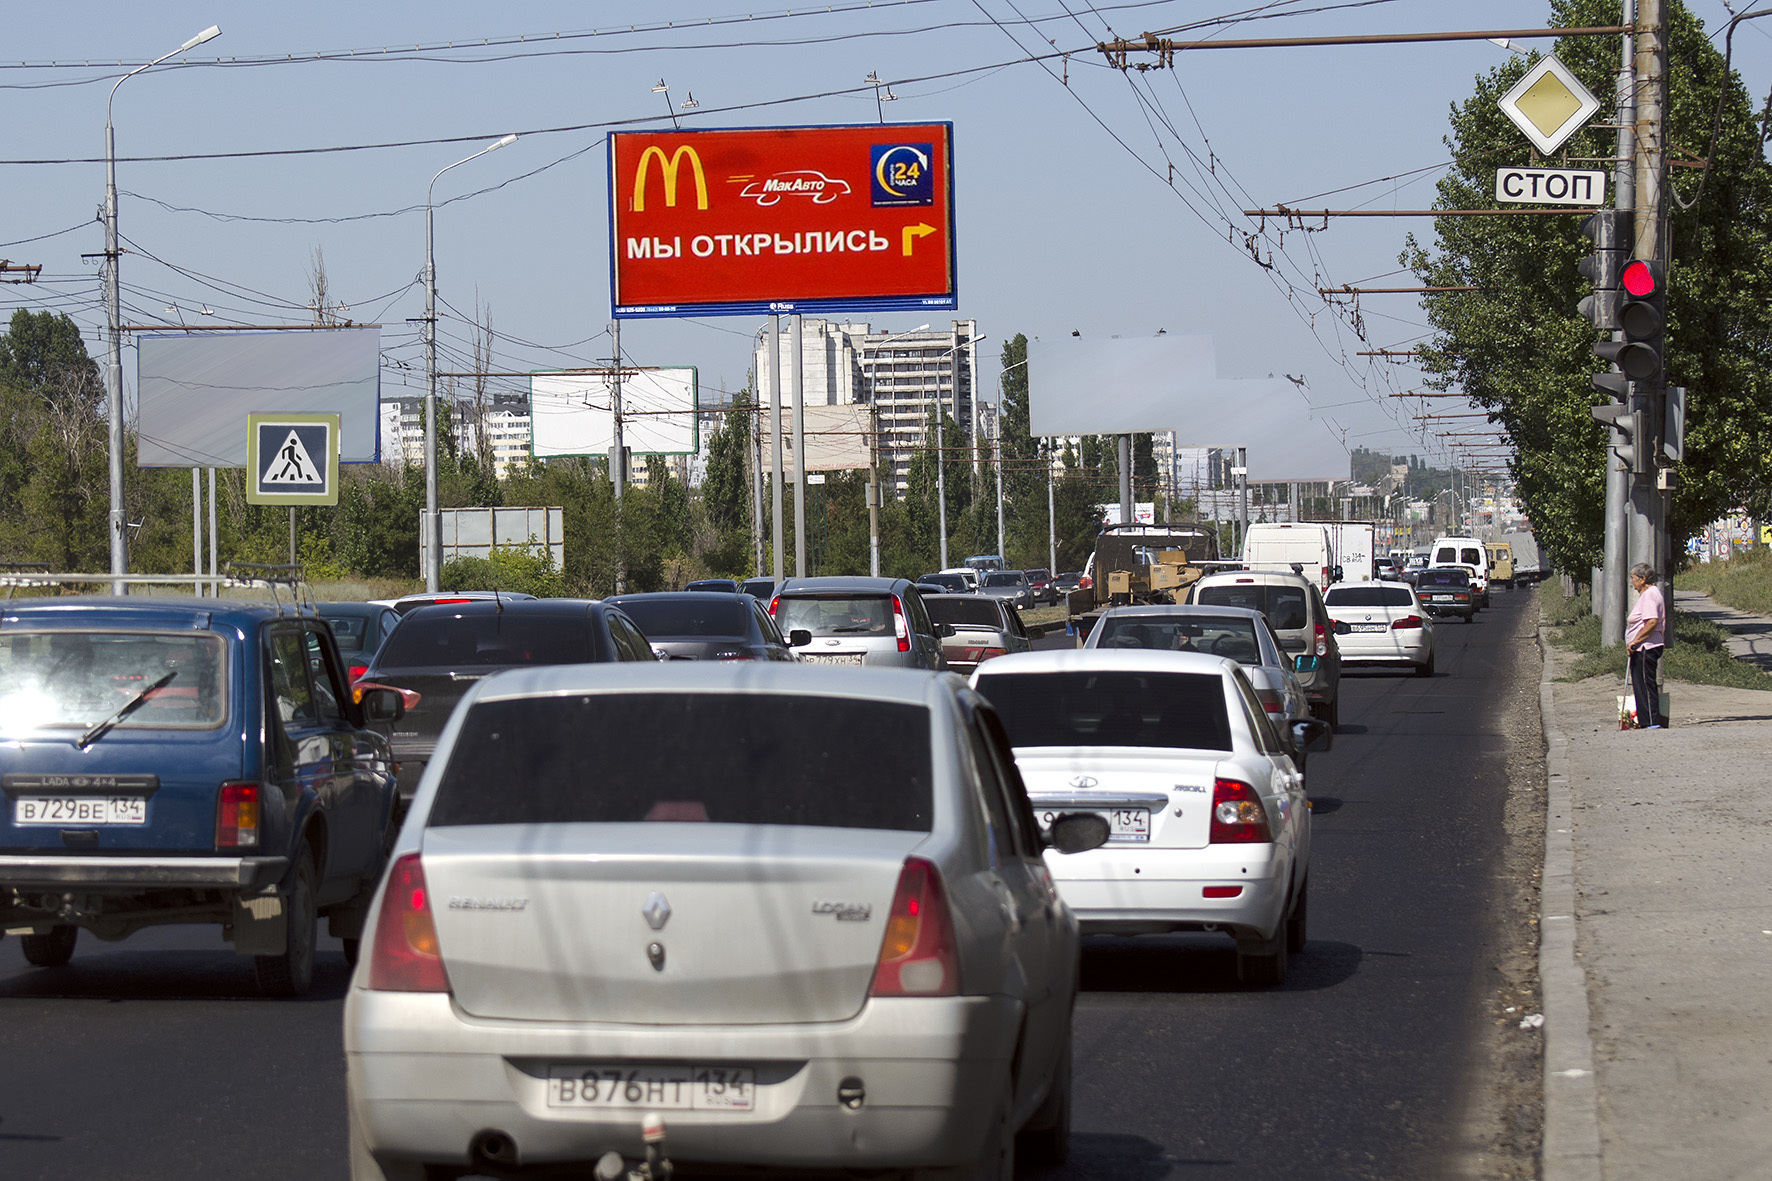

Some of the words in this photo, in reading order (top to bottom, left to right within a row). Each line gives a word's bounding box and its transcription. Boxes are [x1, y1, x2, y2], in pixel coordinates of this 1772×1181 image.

[895, 162, 920, 179] 24
[762, 178, 825, 192] МакАвто
[1503, 172, 1592, 200] СТОП
[627, 238, 681, 260] МЫ
[690, 229, 890, 258] ОТКРЫЛИСЬ
[42, 776, 70, 786] LADA
[24, 798, 104, 819] В729ВЕ
[110, 798, 140, 814] 134
[1113, 809, 1143, 826] 134
[448, 896, 530, 910] RENAULT
[559, 1069, 686, 1103] В876НТ
[697, 1069, 745, 1096] 134
